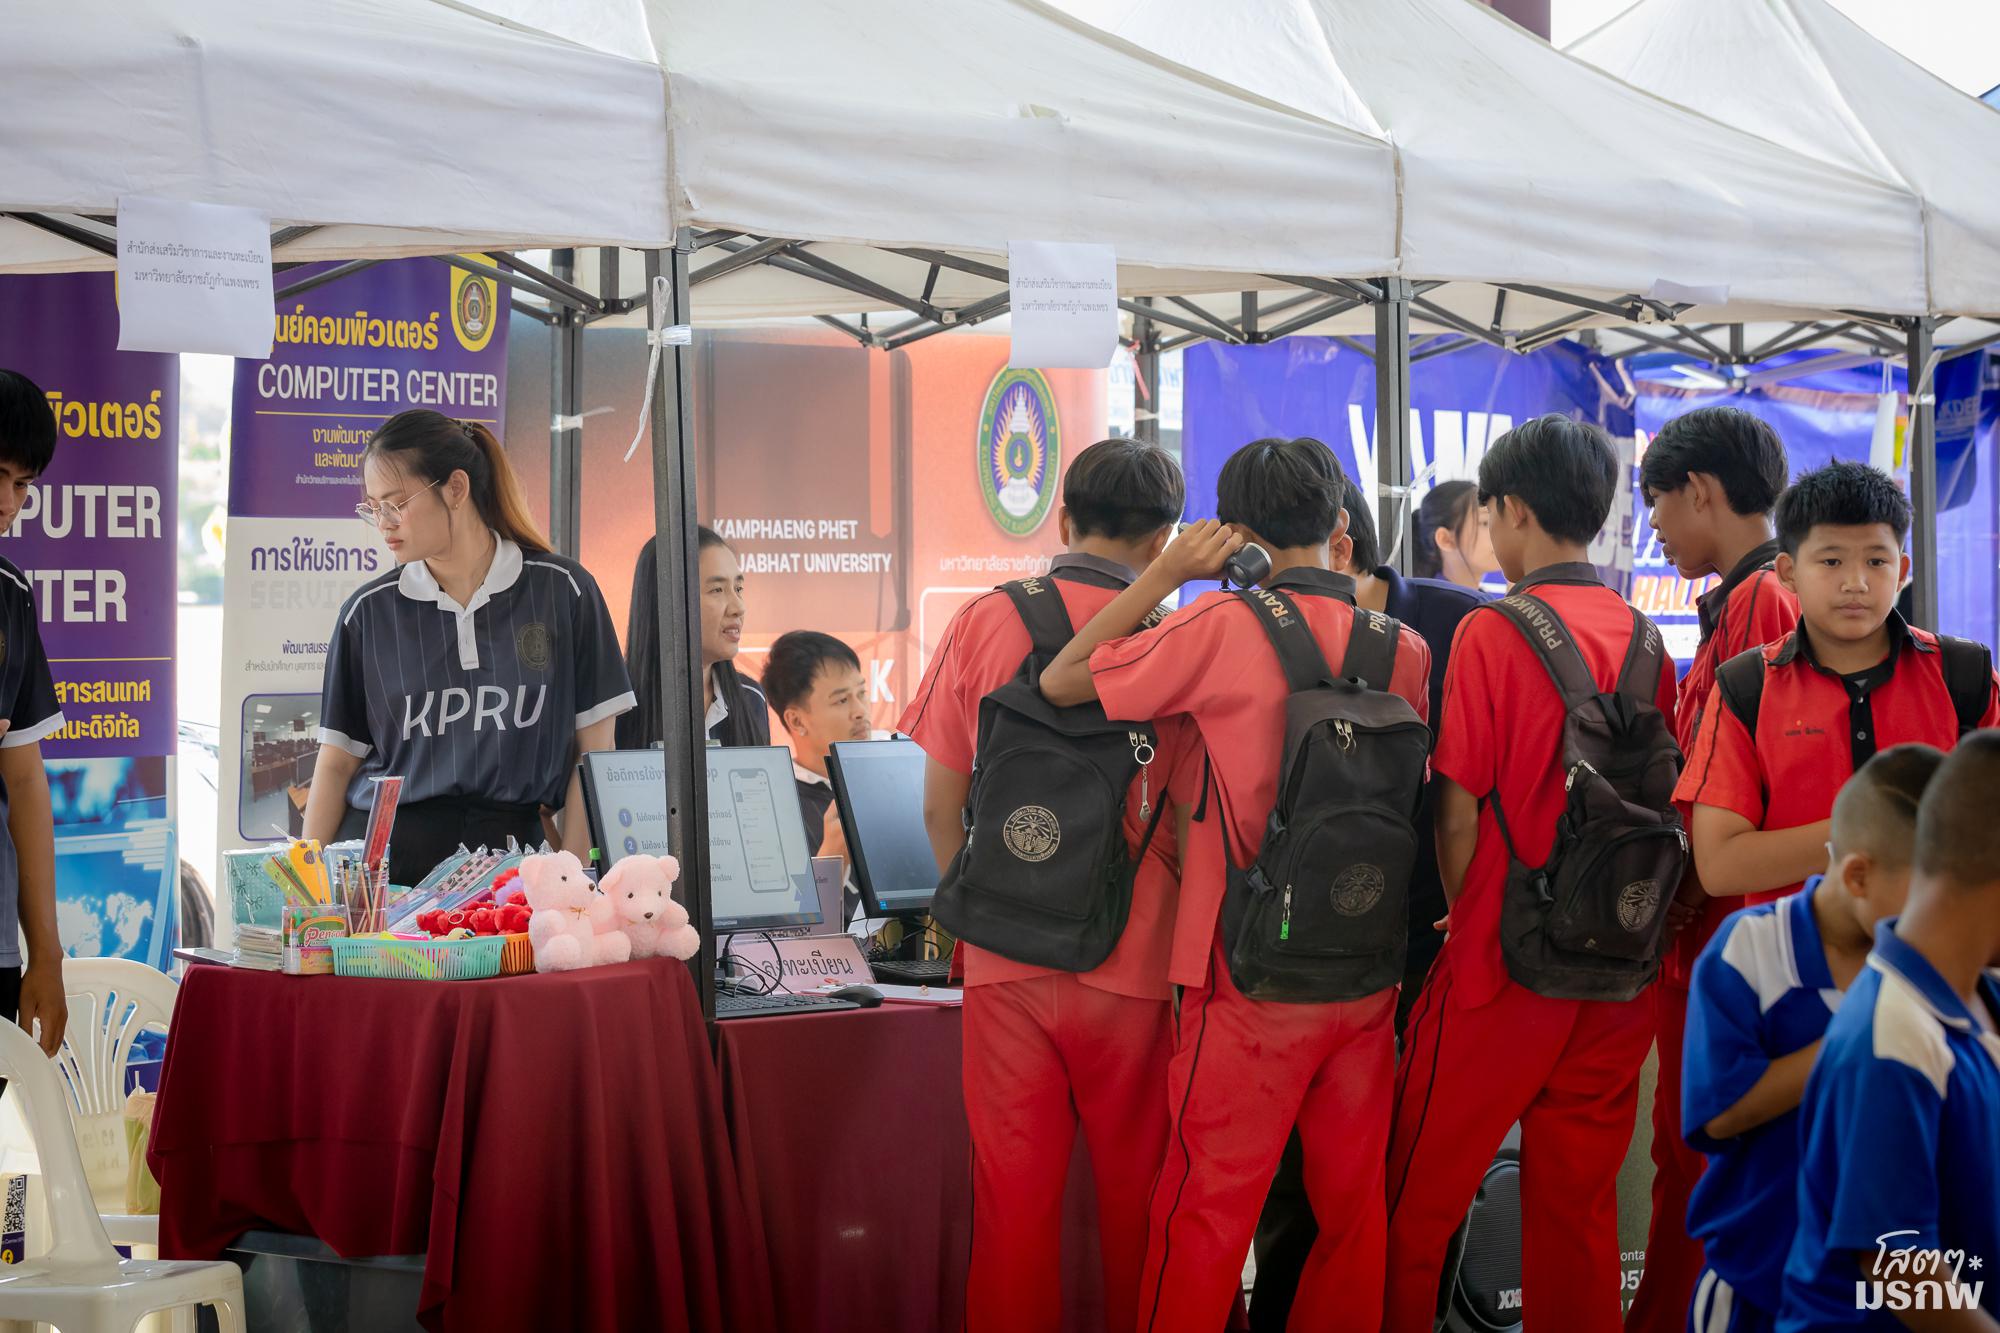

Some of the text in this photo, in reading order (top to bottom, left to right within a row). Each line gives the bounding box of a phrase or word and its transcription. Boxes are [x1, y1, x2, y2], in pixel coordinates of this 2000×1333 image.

[271, 304, 440, 351] นย์คอมพิวเตอร์
[257, 363, 498, 408] COMPUTER CENTER
[0, 485, 162, 538] PUTER
[713, 519, 859, 540] KAMPHAENG PHET
[251, 536, 378, 572] การให้บริการ
[738, 553, 892, 574] JABHAT UNIVERSITY
[24, 570, 128, 623] TER
[402, 684, 547, 741] KPRU
